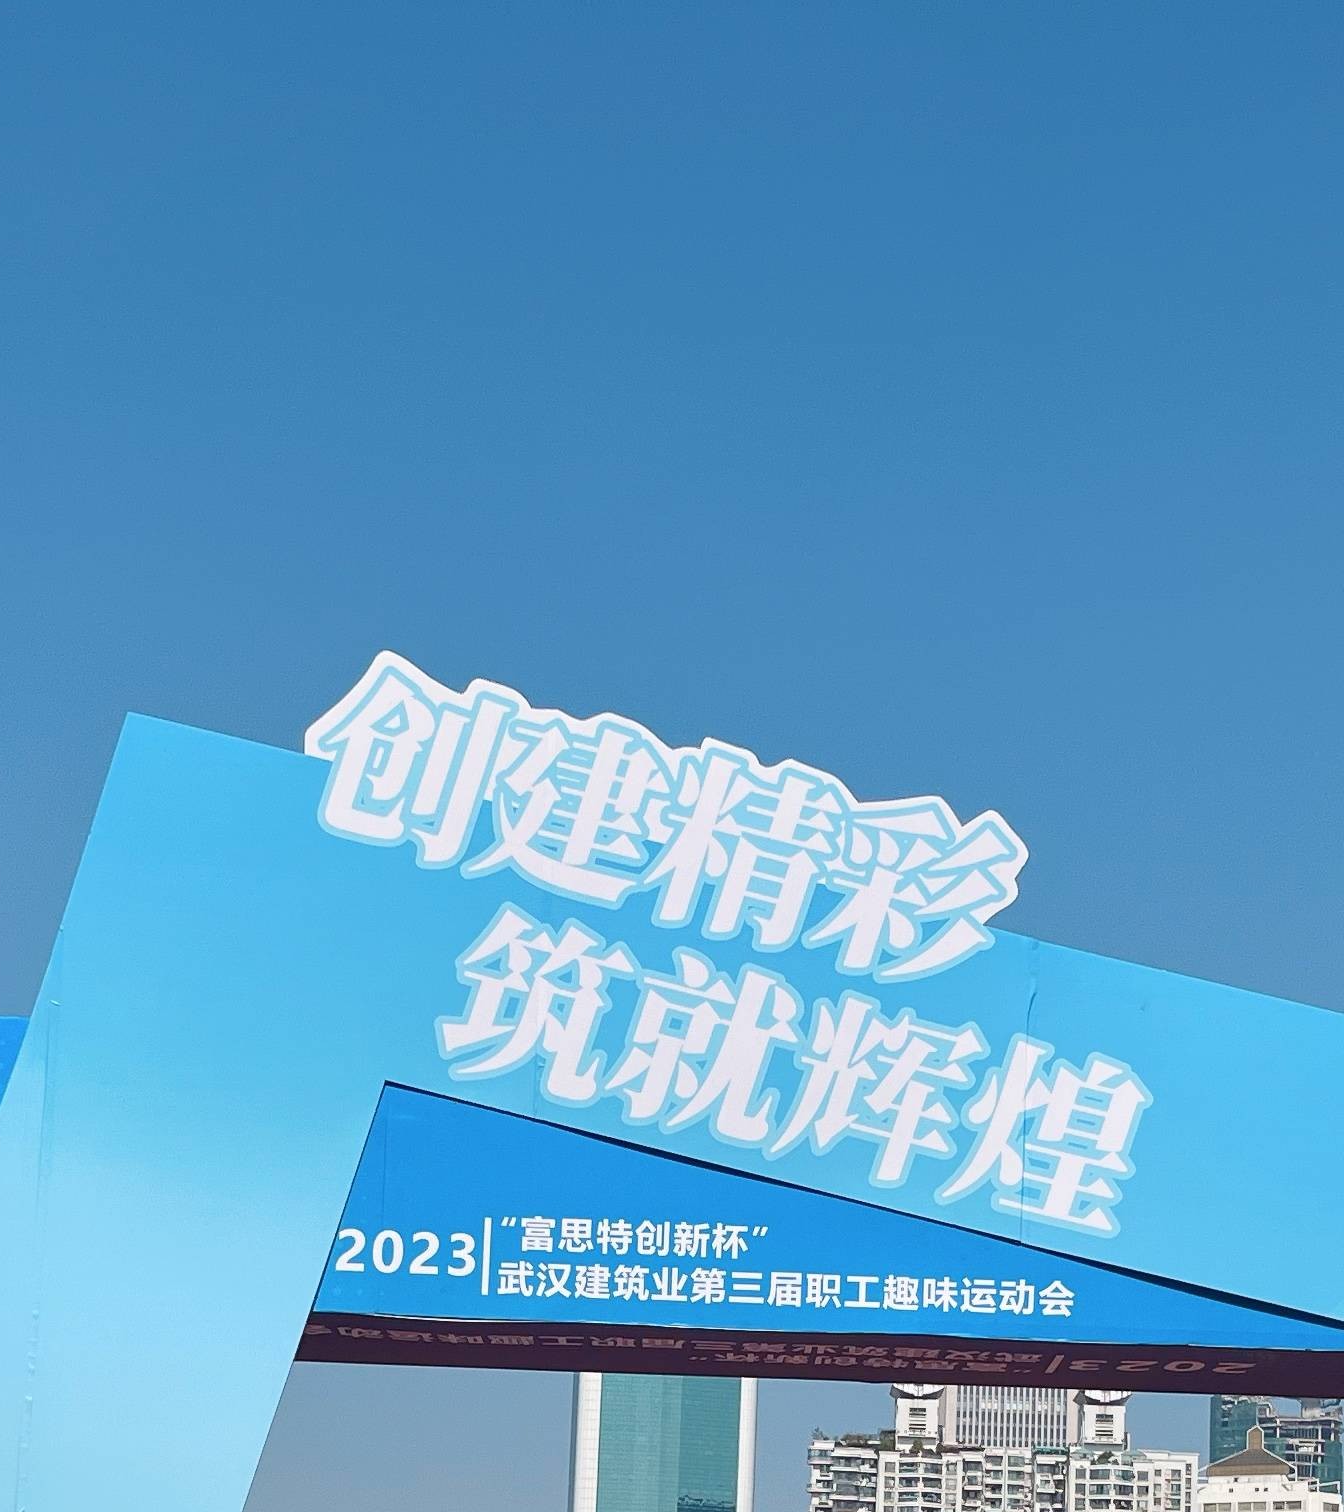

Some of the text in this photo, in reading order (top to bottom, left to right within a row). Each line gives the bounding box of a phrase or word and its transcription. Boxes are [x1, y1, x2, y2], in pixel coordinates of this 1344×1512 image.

[318, 668, 1020, 977] 创建精彩
[437, 905, 1152, 1235] 筑就辉煌
[337, 1229, 476, 1277] 2023
[496, 1261, 1076, 1318] 武汉建筑业第三届职工趣味运动会
